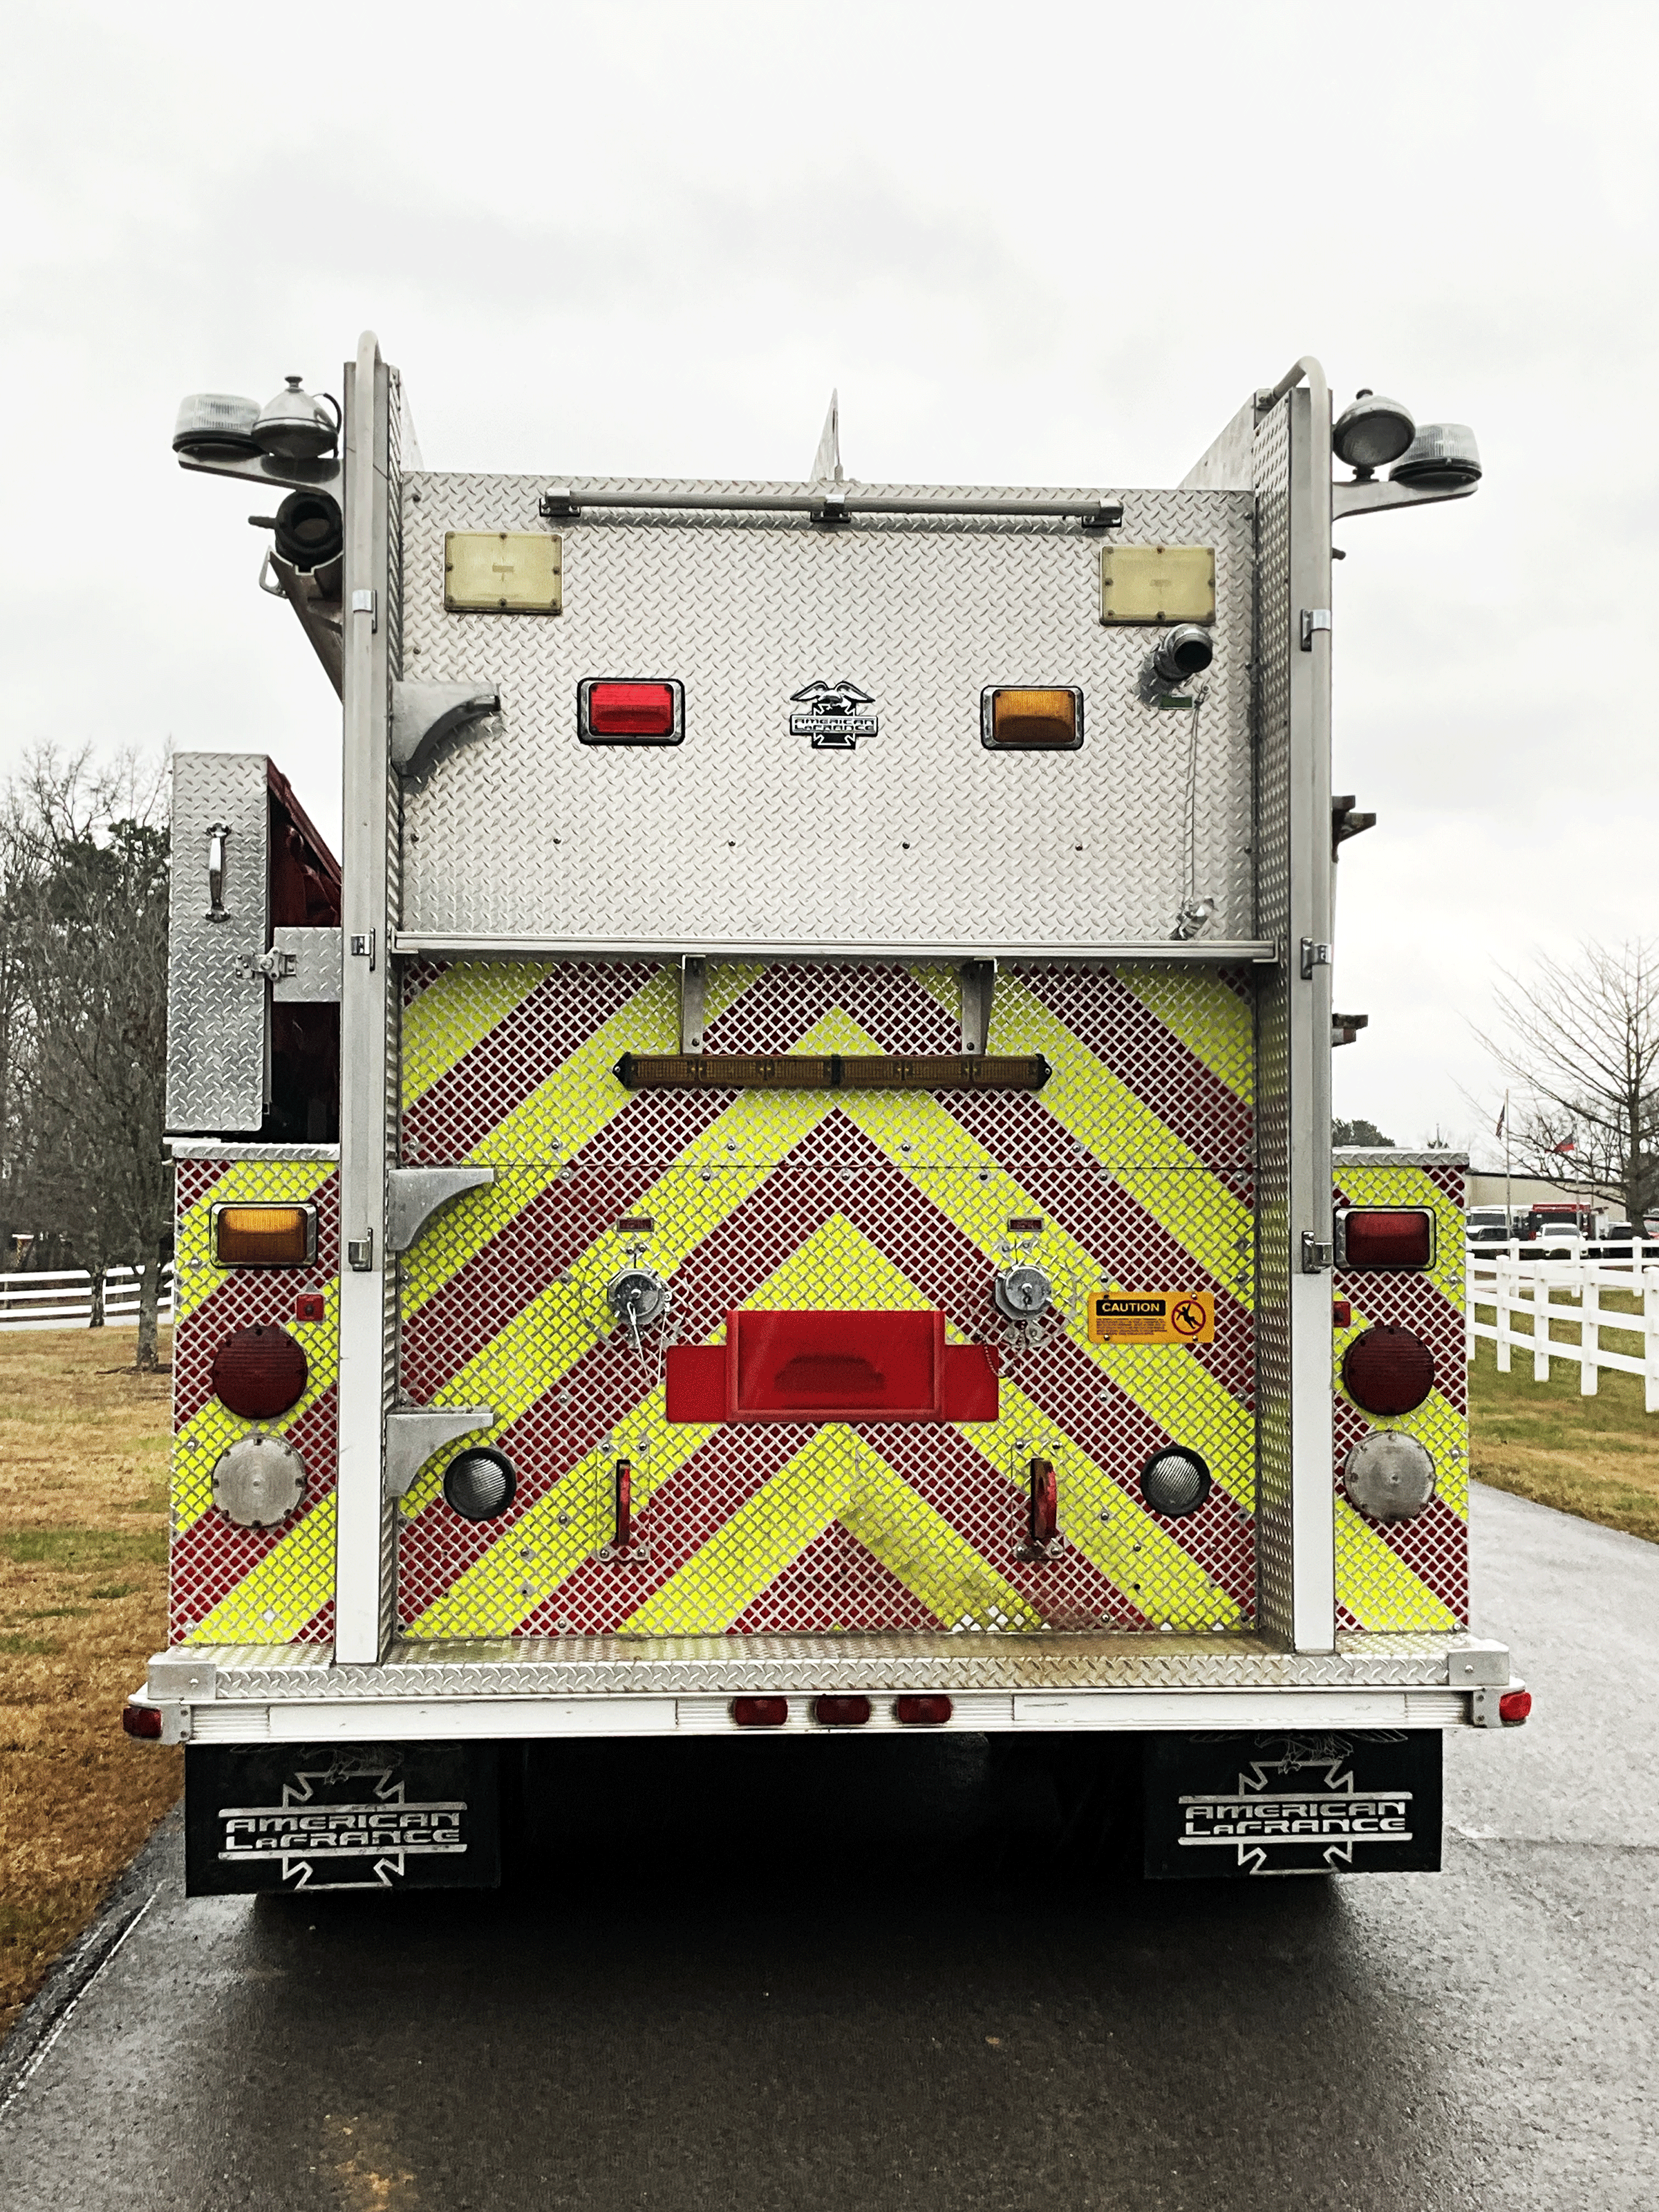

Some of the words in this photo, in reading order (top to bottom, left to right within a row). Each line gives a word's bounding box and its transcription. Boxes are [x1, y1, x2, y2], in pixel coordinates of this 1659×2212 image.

[1102, 1302, 1160, 1313] CAUTION
[1185, 1801, 1405, 1819] AMERICAN
[226, 1812, 460, 1833] AMERICAN
